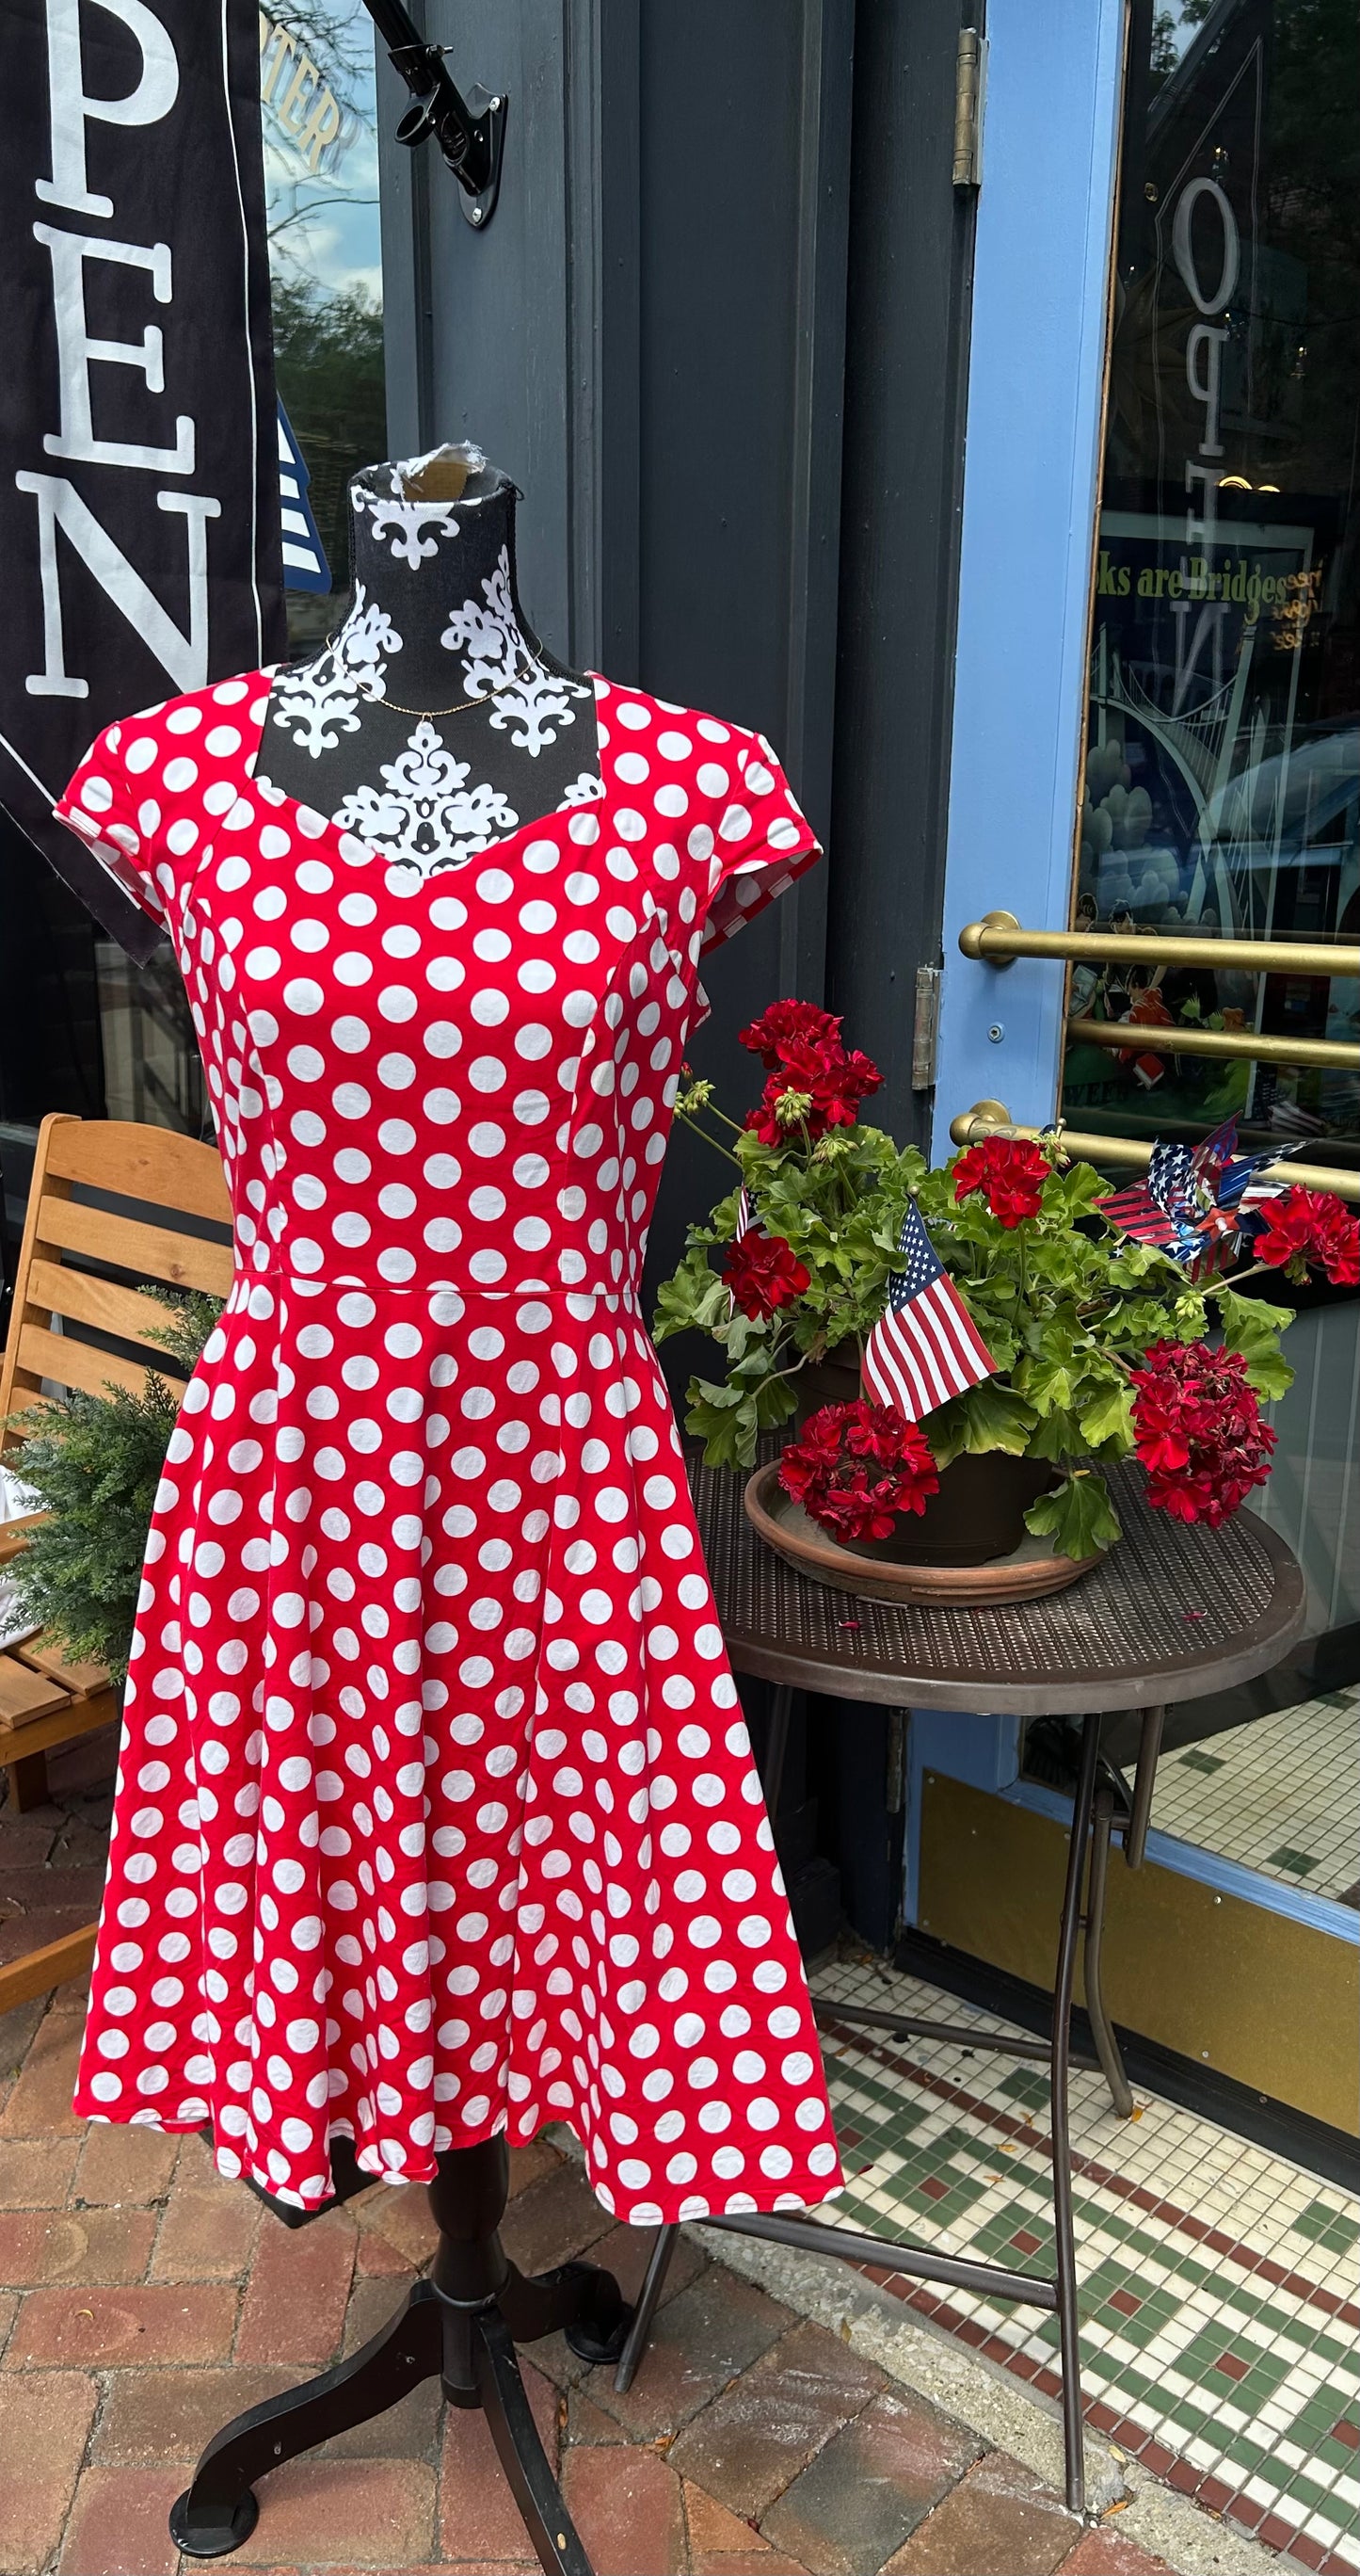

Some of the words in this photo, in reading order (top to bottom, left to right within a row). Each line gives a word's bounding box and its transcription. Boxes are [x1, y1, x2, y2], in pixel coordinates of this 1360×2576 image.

[260, 10, 340, 175] TER
[1096, 550, 1130, 596] ks
[1137, 567, 1183, 599] are
[1188, 556, 1287, 625] Bridges
